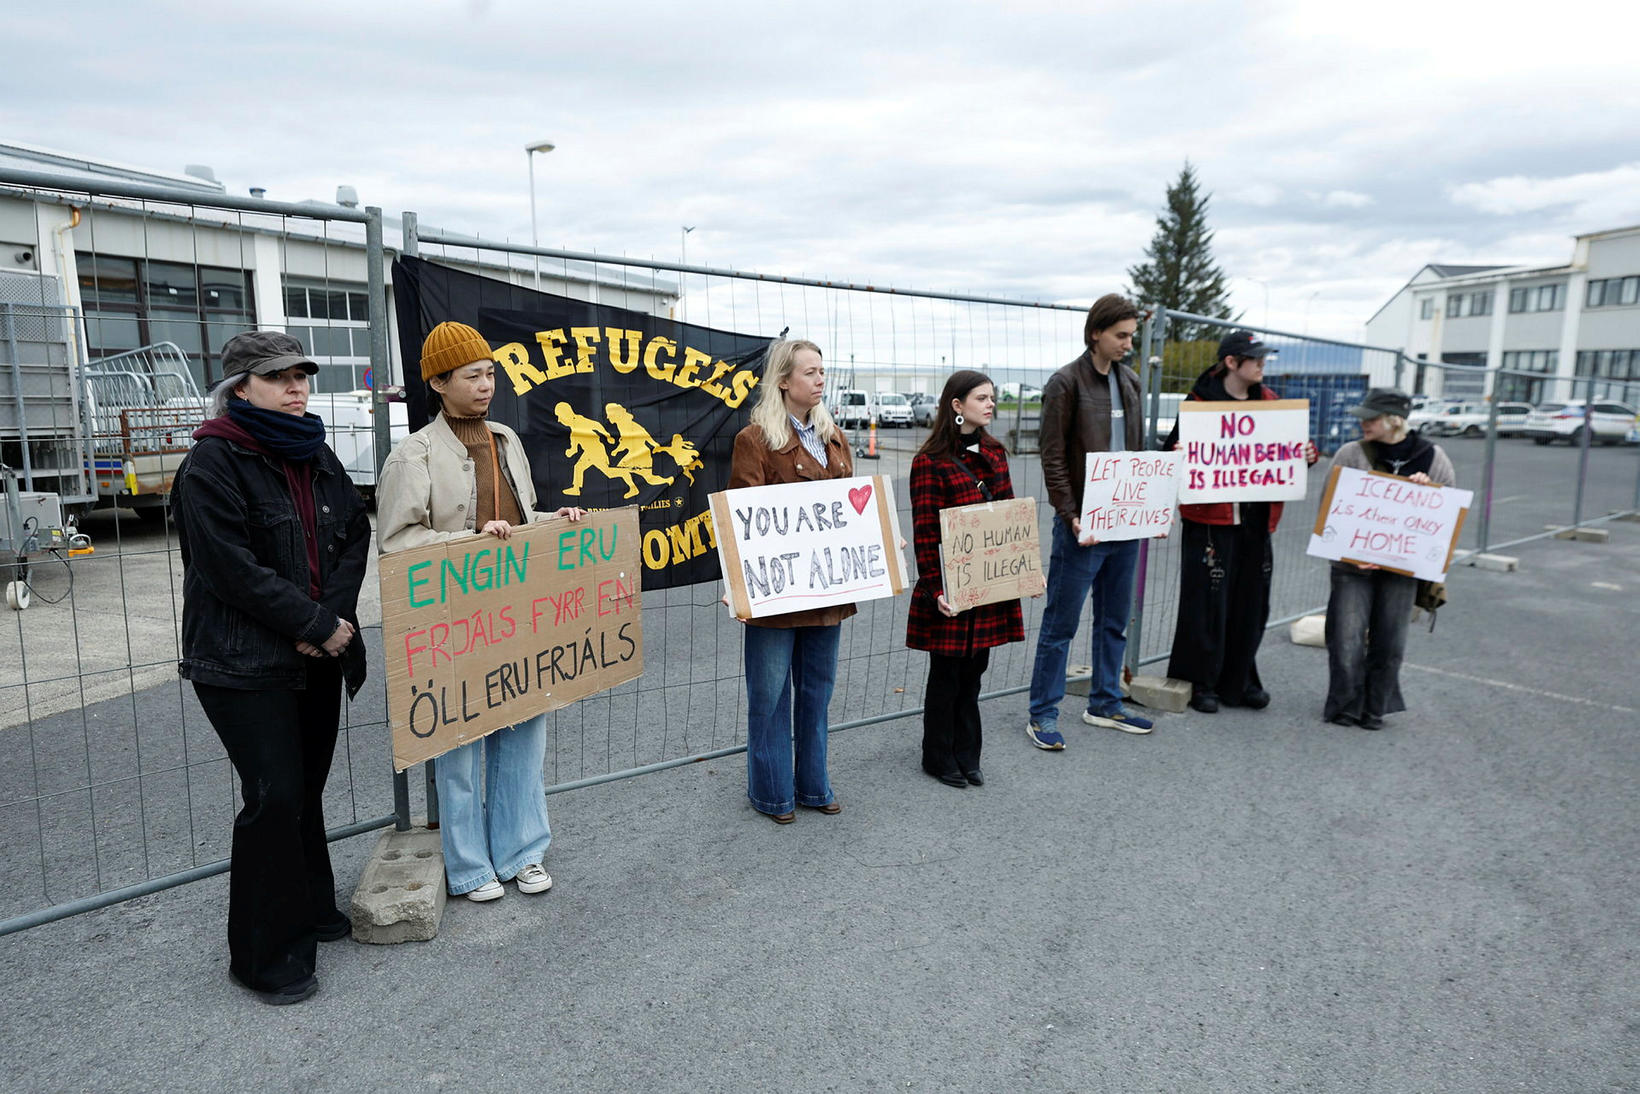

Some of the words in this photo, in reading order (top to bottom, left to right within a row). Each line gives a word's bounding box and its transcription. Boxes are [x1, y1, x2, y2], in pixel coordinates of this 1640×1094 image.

[491, 326, 759, 409] REFUGEES
[1220, 412, 1255, 439] NO
[1090, 457, 1121, 482] LET
[1129, 457, 1175, 477] PEOPLE
[1188, 441, 1252, 466] HUMAN
[1254, 441, 1303, 464] BEING
[1112, 480, 1148, 501] LIVE
[1188, 469, 1206, 490] IS
[1212, 465, 1294, 489] ILLEGAL!
[1355, 477, 1444, 510] ICELAND
[735, 506, 789, 541] YOU
[796, 501, 848, 533] ARE
[1087, 506, 1127, 530] THEIR
[1129, 507, 1171, 526] LIVES
[1331, 499, 1355, 516] is
[1403, 516, 1444, 536] ONLY
[952, 531, 974, 555] NO
[983, 524, 1031, 548] HUMAN
[1349, 528, 1417, 554] HOME
[408, 541, 529, 608] ENGIN
[558, 523, 618, 571] ERU
[744, 552, 800, 599] NOT
[809, 544, 885, 590] ALONE
[957, 562, 972, 589] IS
[983, 553, 1037, 582] ILLEGAL
[405, 605, 517, 678] FRJÁLS
[532, 586, 586, 634] FYRR
[598, 572, 634, 618] EN
[409, 678, 481, 738] ÖLL
[485, 657, 530, 709] ERU
[536, 622, 636, 690] FRJÁLS
